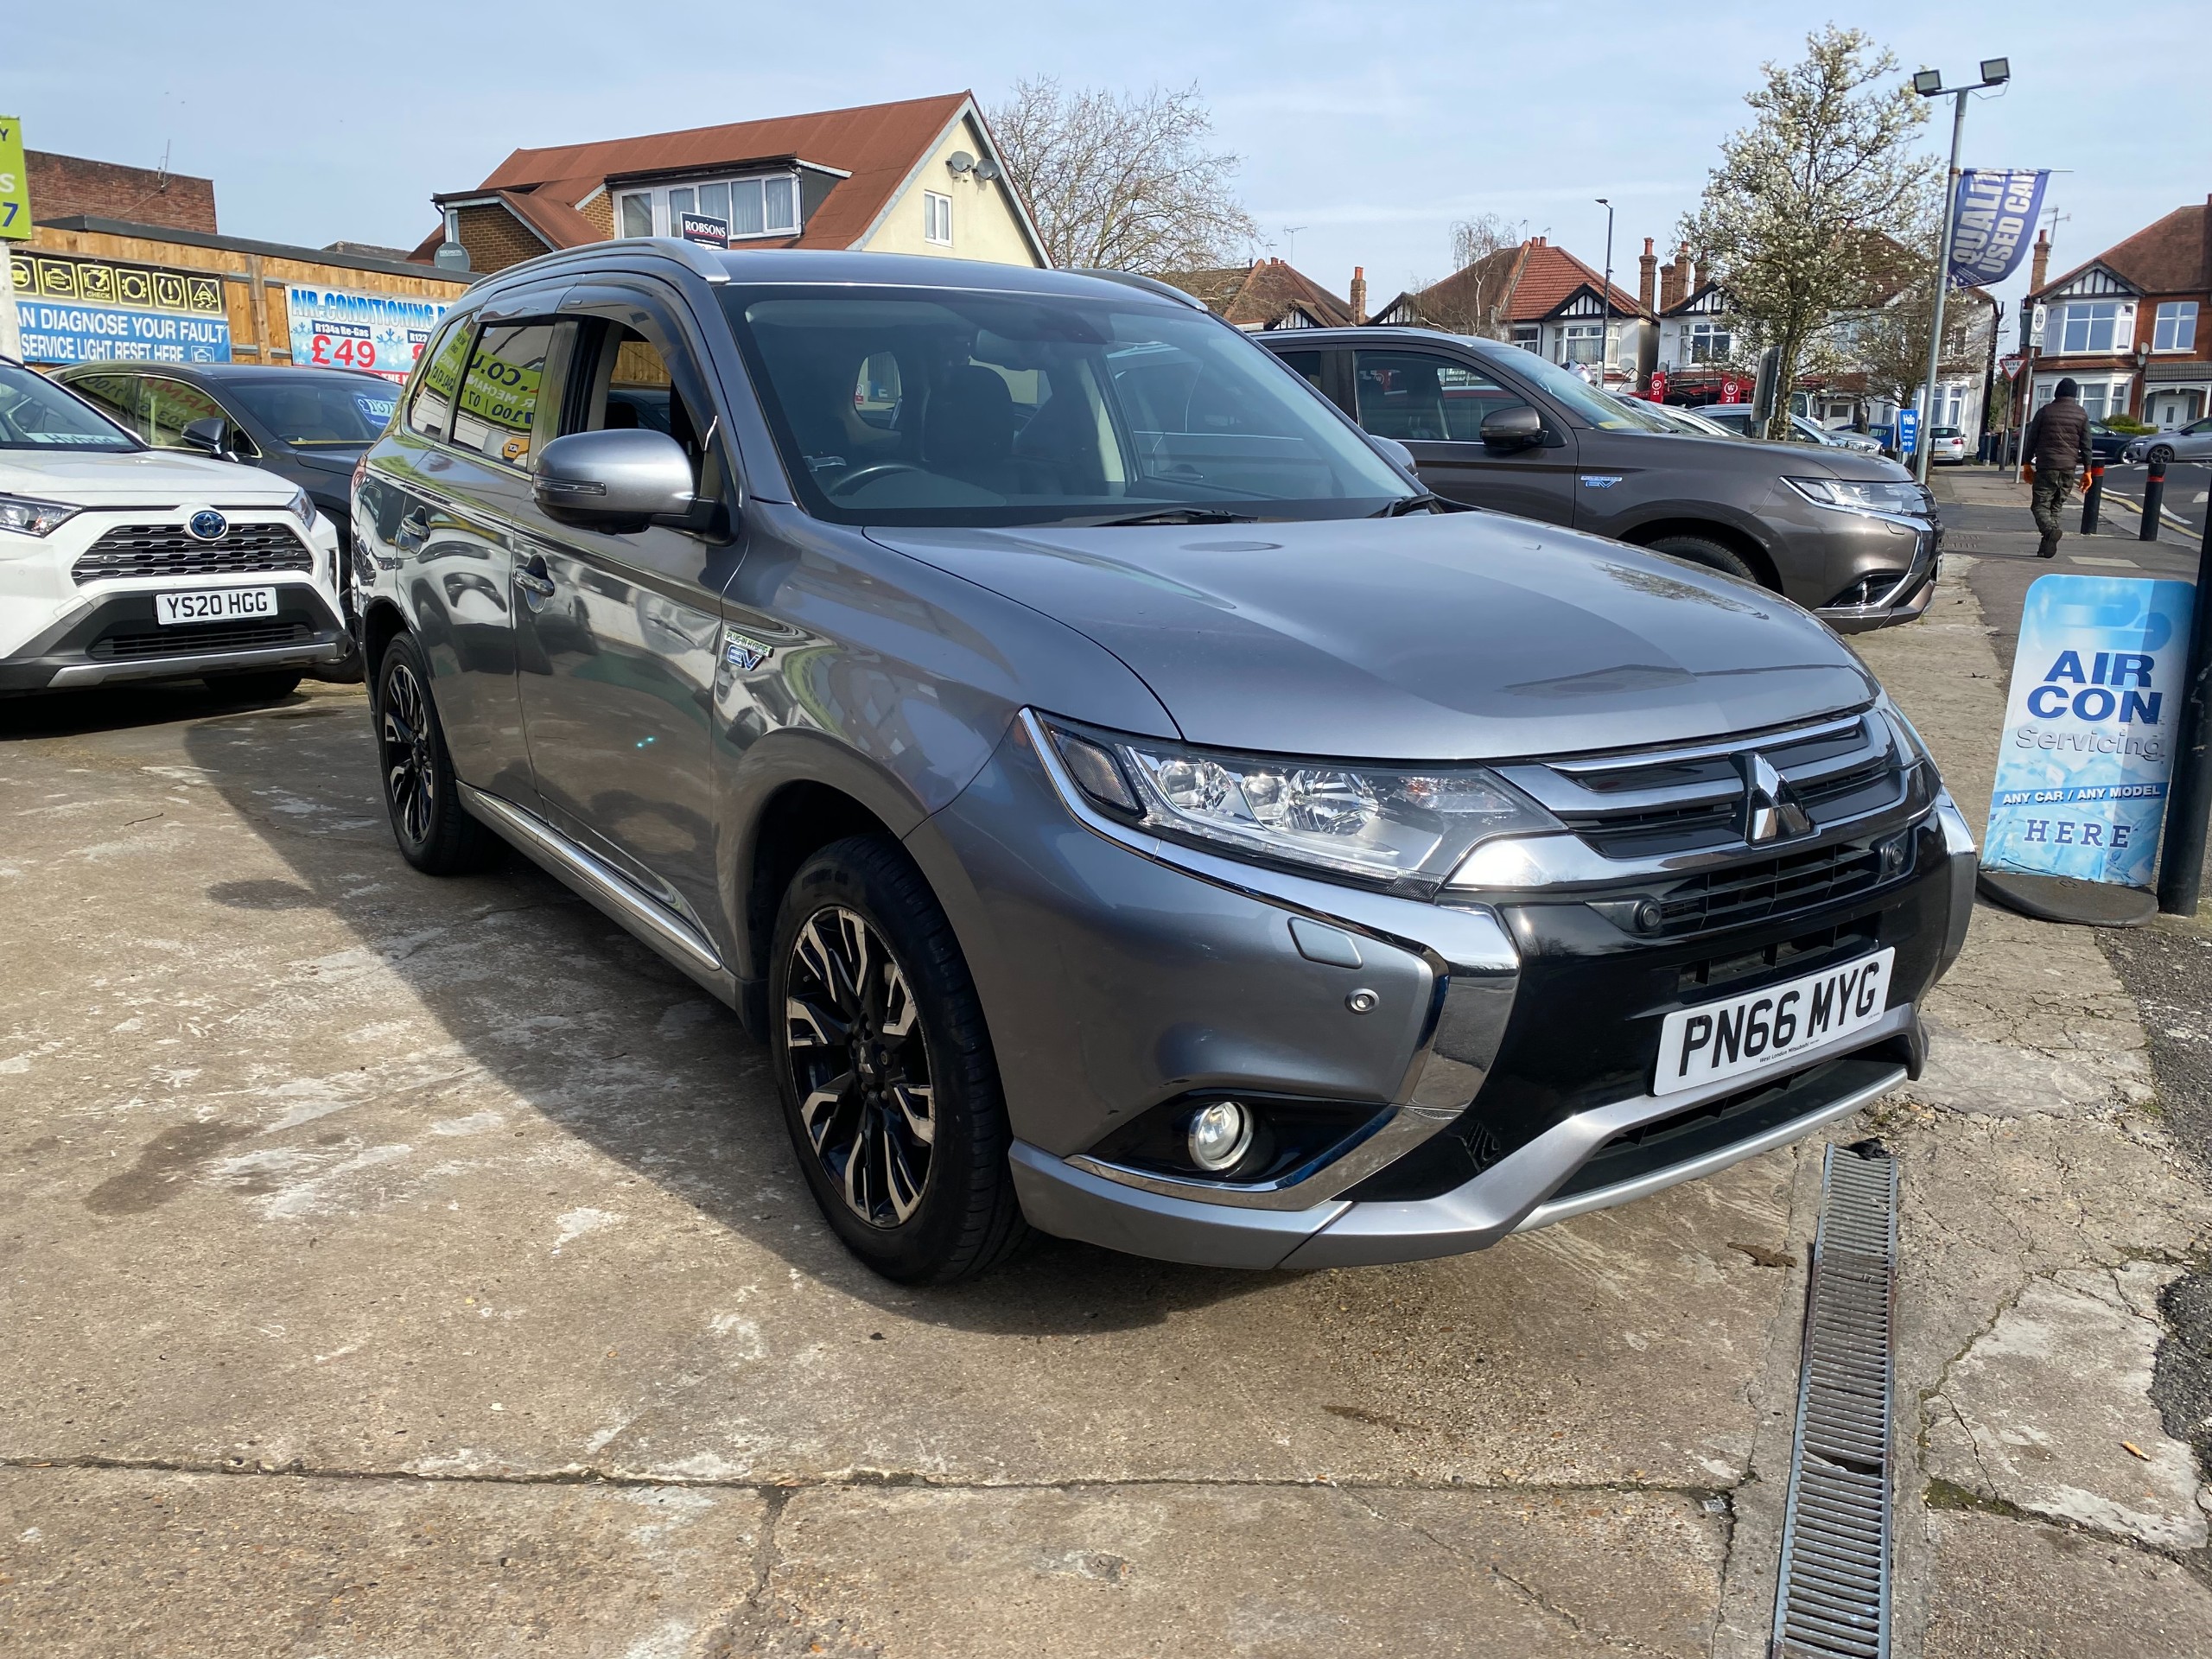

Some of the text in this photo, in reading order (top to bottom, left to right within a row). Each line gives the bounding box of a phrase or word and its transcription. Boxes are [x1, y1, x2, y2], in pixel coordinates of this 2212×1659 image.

[684, 220, 726, 238] ROBSONS
[86, 290, 111, 299] CHECK
[41, 308, 129, 336] DIAGNOSE
[131, 316, 176, 340] YOUR
[180, 321, 225, 344] FAULT
[21, 333, 76, 359] SERVICE
[77, 338, 112, 361] LIGHT
[311, 334, 376, 368] £49
[43, 434, 117, 445] Hybrid
[167, 591, 268, 619] YS20 HGG
[727, 644, 764, 671] EV
[2043, 650, 2156, 688] AIR
[2026, 685, 2164, 725] CON
[2015, 725, 2166, 763] Servicing
[2002, 792, 2031, 805] ANY
[2035, 791, 2064, 803] CAR
[2077, 788, 2107, 800] ANY
[2110, 785, 2161, 798] MODEL
[2024, 819, 2132, 849] HERE
[1678, 961, 1880, 1077] PN66 MYG
[1771, 1051, 1788, 1059] London
